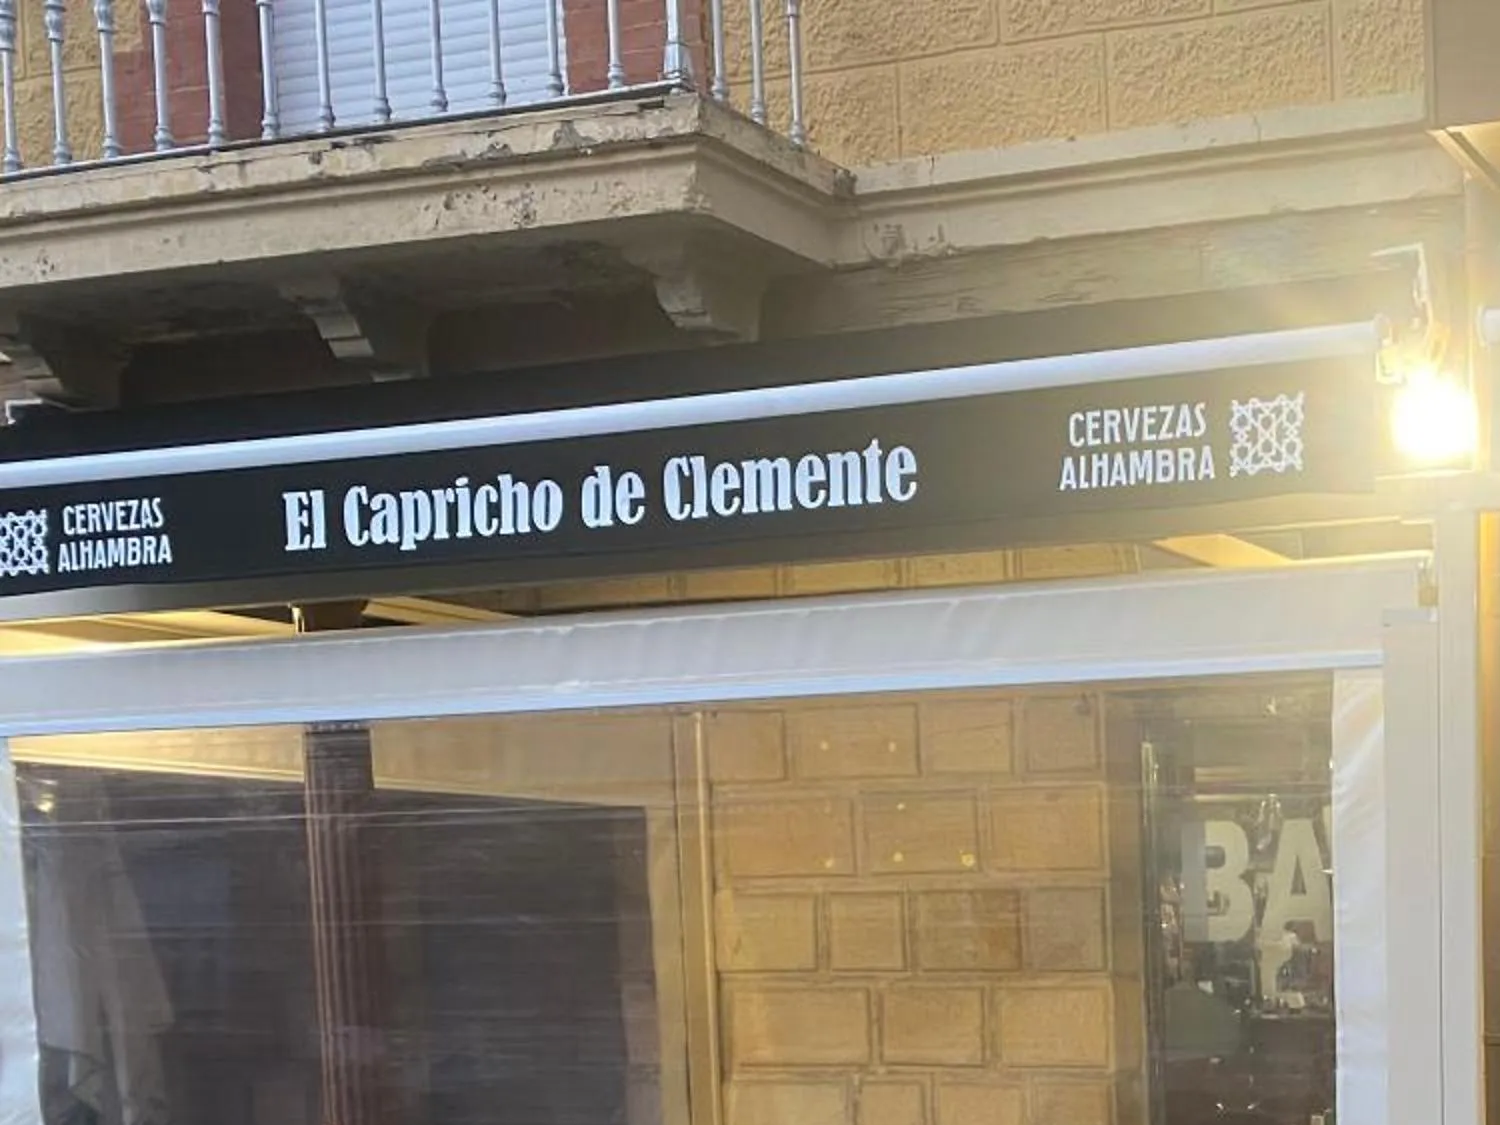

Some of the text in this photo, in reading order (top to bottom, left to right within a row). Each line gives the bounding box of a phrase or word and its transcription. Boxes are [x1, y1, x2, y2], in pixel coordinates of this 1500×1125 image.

[1068, 402, 1208, 449] CERVEZAS
[1059, 446, 1216, 491] ALHAMBRA
[61, 497, 165, 535] CERVEZAS
[282, 437, 918, 553] El Capricho de Clemente
[57, 534, 173, 573] ALHAMBRA
